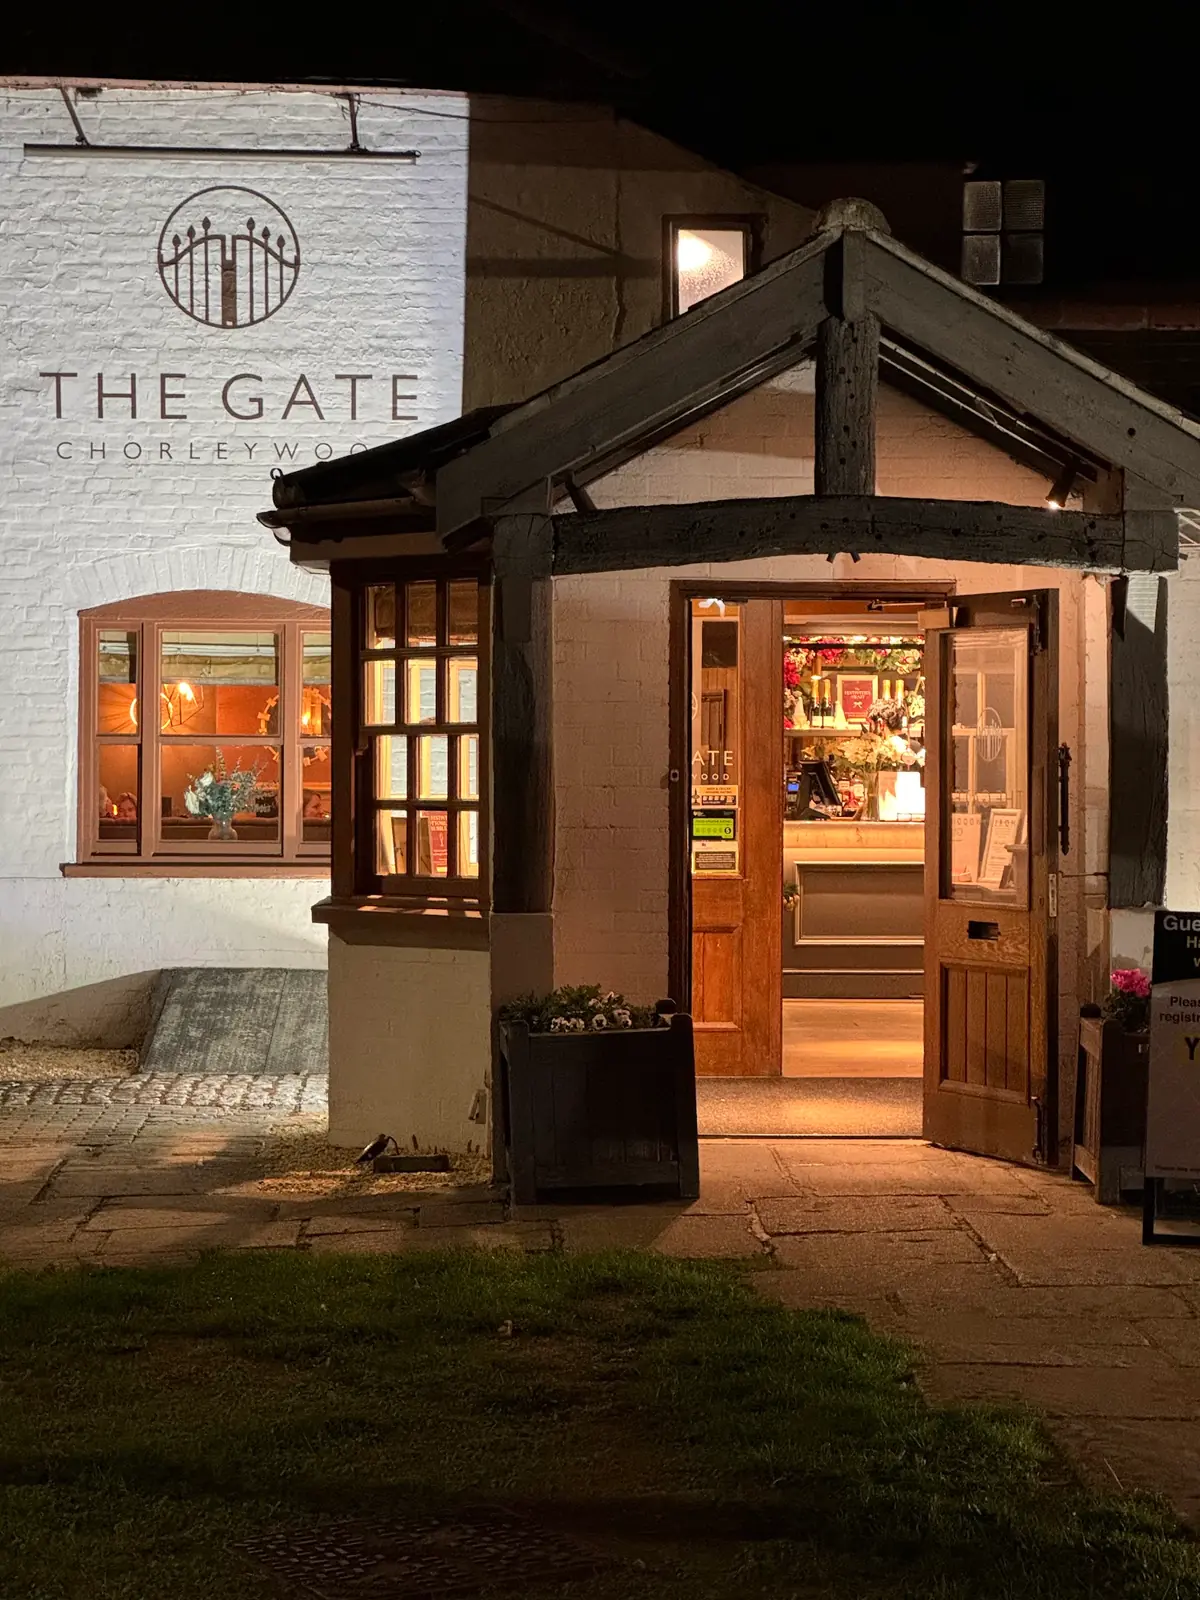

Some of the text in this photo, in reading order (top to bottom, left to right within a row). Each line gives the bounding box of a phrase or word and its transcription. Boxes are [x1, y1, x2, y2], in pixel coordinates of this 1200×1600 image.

[39, 372, 419, 421] THE GATE
[692, 750, 734, 766] ATE
[1163, 914, 1200, 932] Gue
